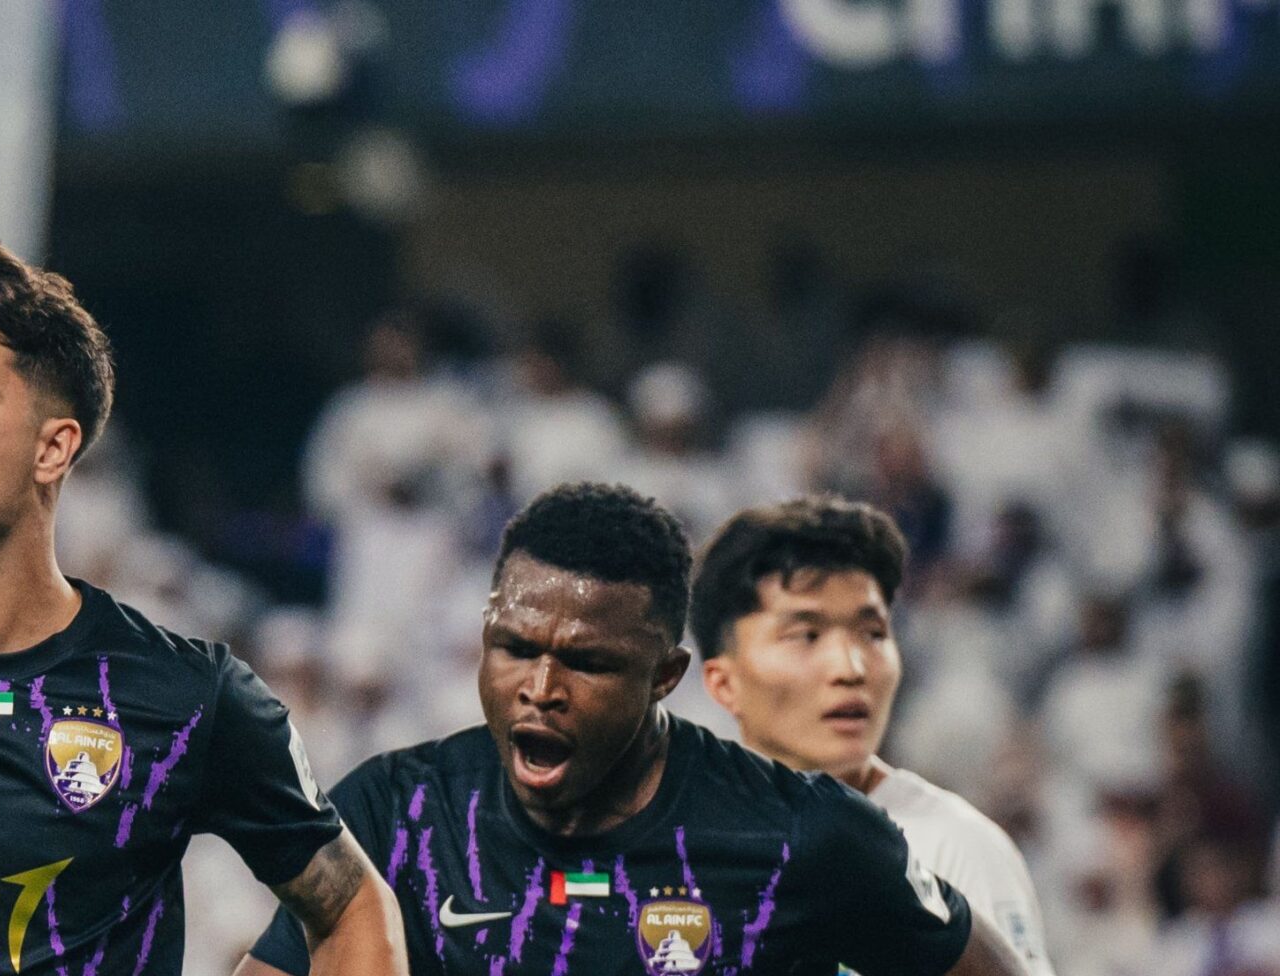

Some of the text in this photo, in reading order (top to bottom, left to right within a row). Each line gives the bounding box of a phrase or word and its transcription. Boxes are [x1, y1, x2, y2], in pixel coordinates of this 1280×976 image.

[97, 739, 114, 752] FC
[646, 913, 703, 928] AL AIN FC
